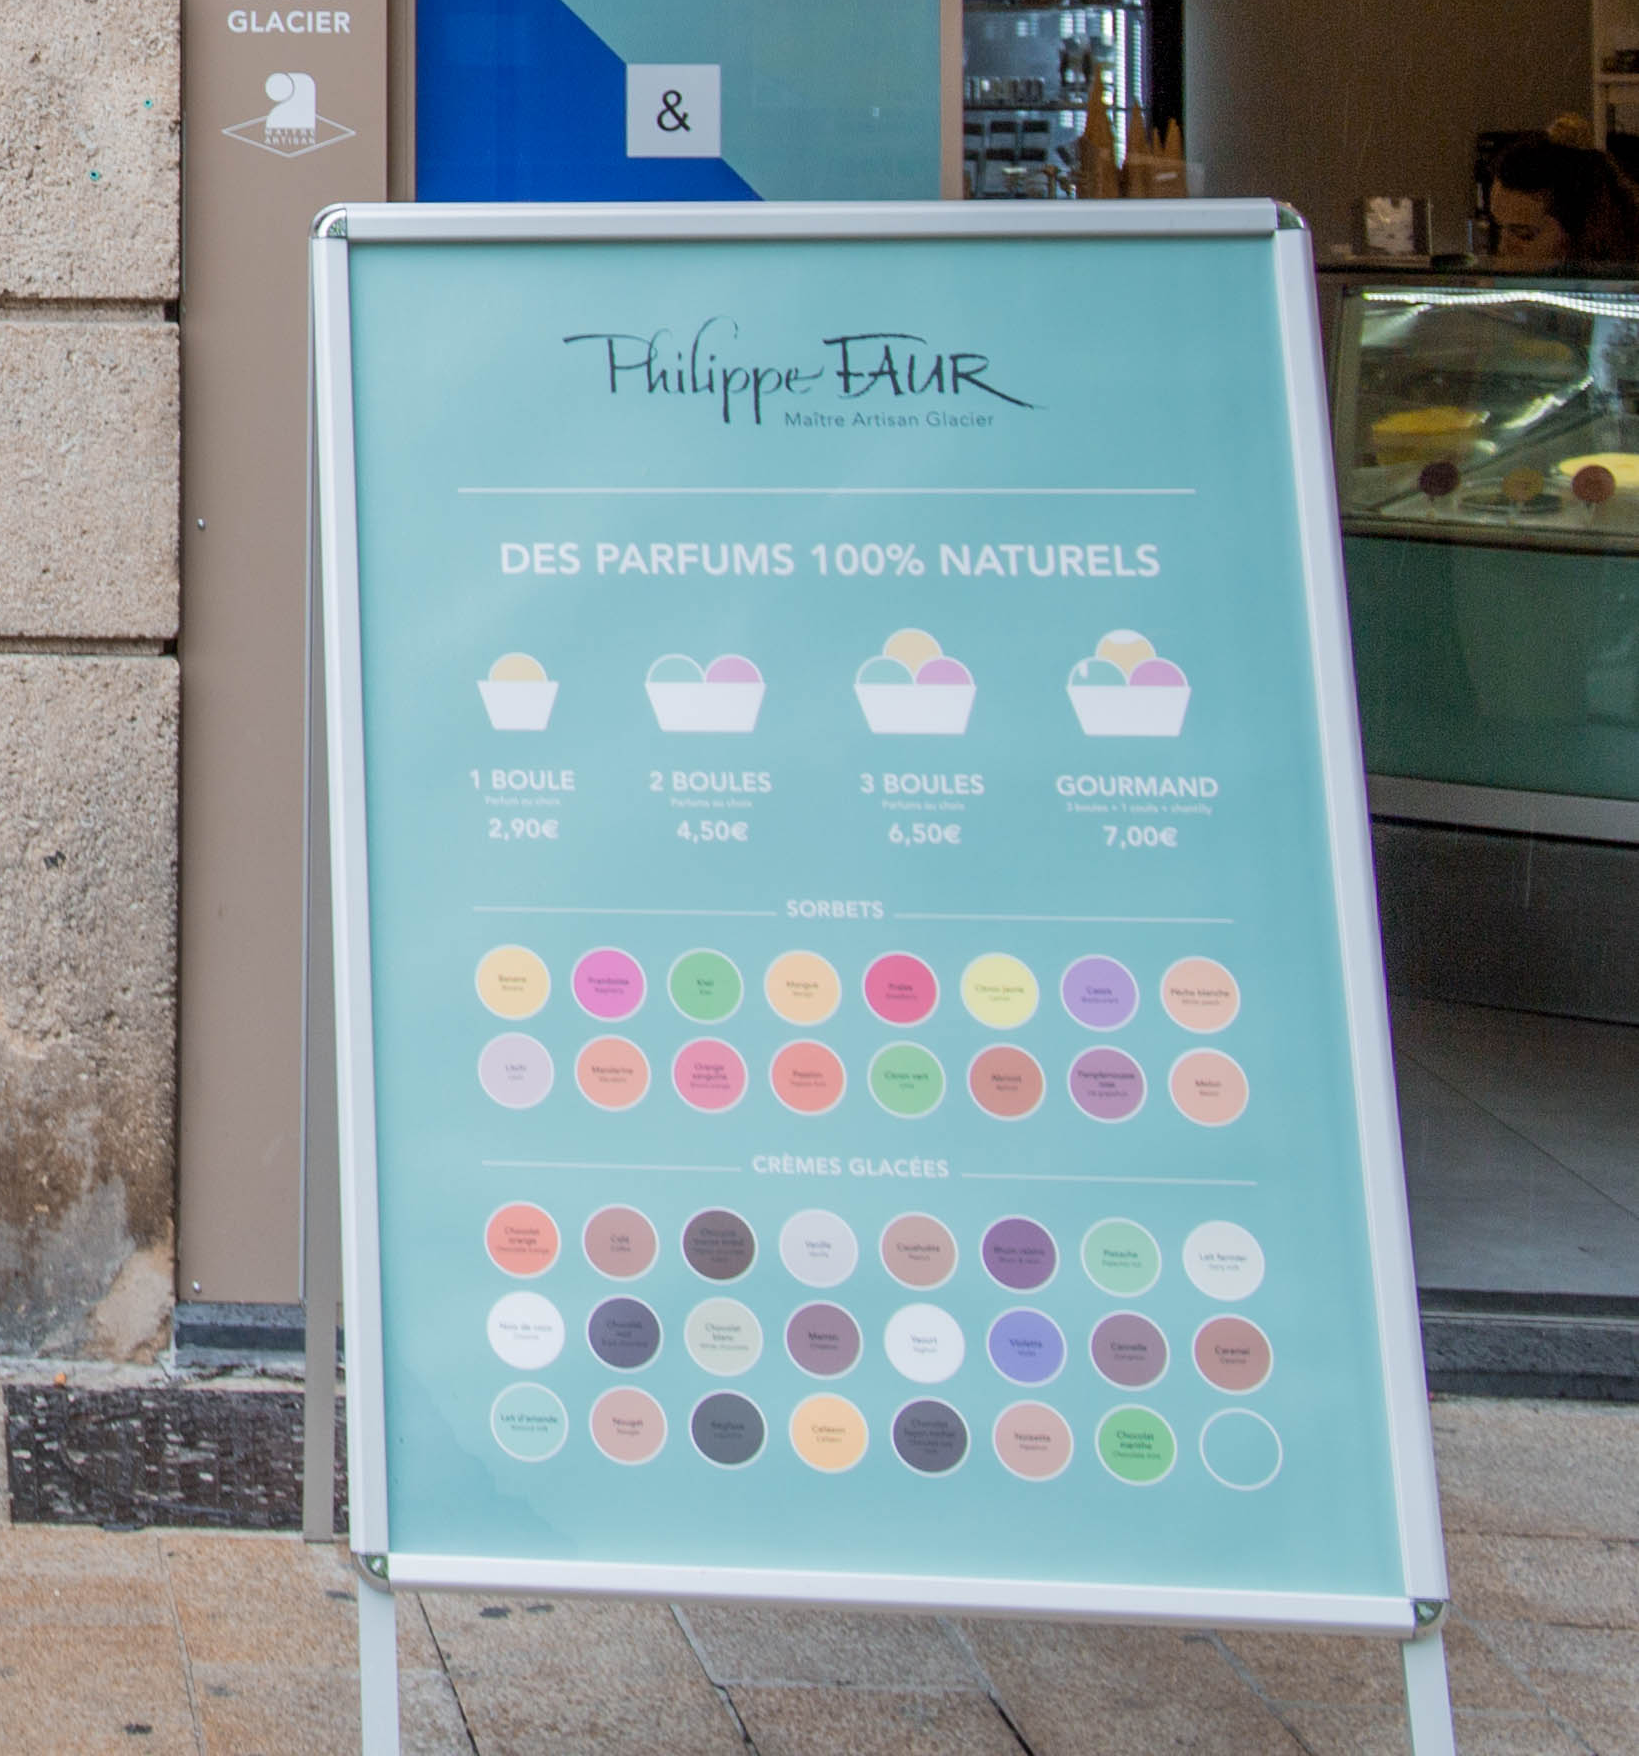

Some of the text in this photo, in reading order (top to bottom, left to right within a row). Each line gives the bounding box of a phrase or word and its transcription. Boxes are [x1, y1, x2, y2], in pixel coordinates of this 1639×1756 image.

[227, 10, 352, 34] GLACIER
[656, 90, 691, 132] &
[563, 316, 1047, 425] Philippe FAUR
[784, 410, 995, 429] Maître Artisan Glacier
[500, 543, 1161, 578] DES PARFUMS 100% NATURELS
[469, 770, 576, 791] 1 BOULE
[650, 772, 772, 793] 2 BOULES
[860, 774, 985, 795] 3 BOULES
[1056, 775, 1218, 797] GOURMAND
[488, 818, 559, 842] 2,90€
[677, 821, 748, 844] 4,50€
[888, 824, 962, 847] 6,50€
[1102, 826, 1178, 849] 7,00€
[786, 899, 884, 919] SORBETS
[752, 1153, 949, 1179] CRÈMES GLACÉES
